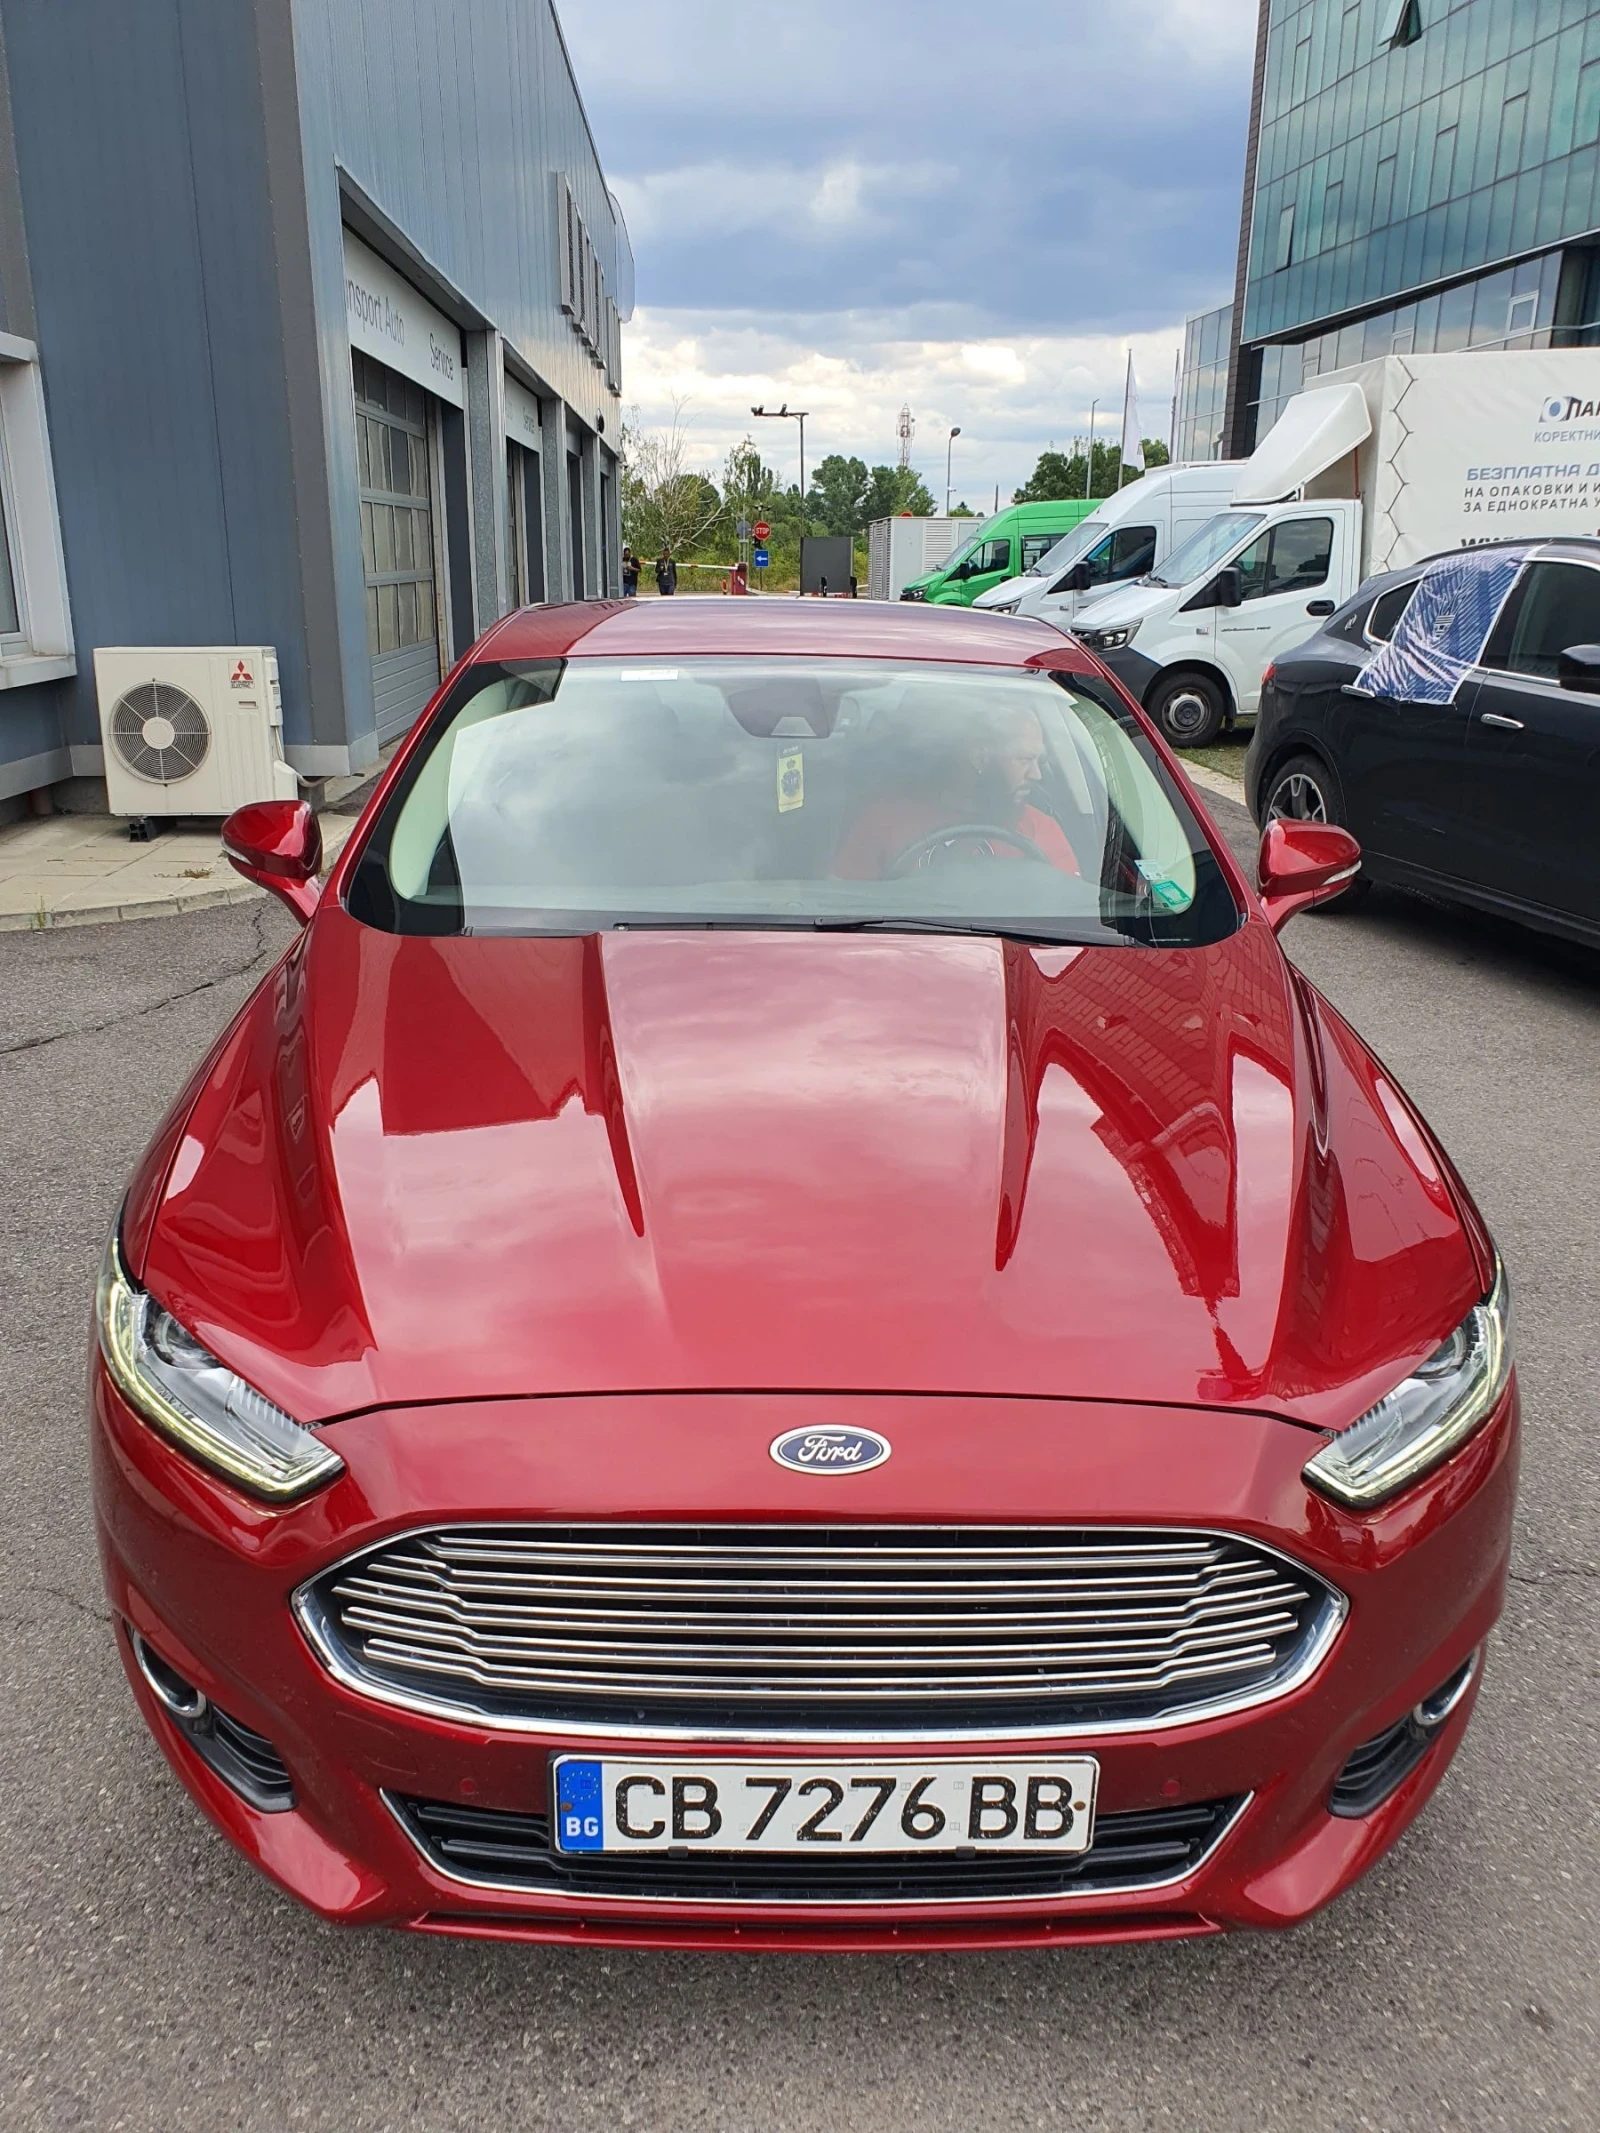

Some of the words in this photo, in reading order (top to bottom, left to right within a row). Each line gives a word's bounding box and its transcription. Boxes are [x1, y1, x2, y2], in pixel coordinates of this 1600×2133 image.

[385, 296, 405, 347] Auto
[429, 332, 454, 381] Service
[1466, 464, 1581, 481] БЕЗПЛАТНА
[1464, 487, 1485, 498] НА
[1489, 483, 1574, 498] ОПАКОВКИ
[1578, 482, 1588, 493] И
[1463, 501, 1482, 513] ЗА
[1487, 497, 1588, 513] ЕДНОКРАТНА
[798, 1435, 863, 1462] Ford
[745, 1776, 947, 1843] 7276
[566, 1816, 599, 1837] BG
